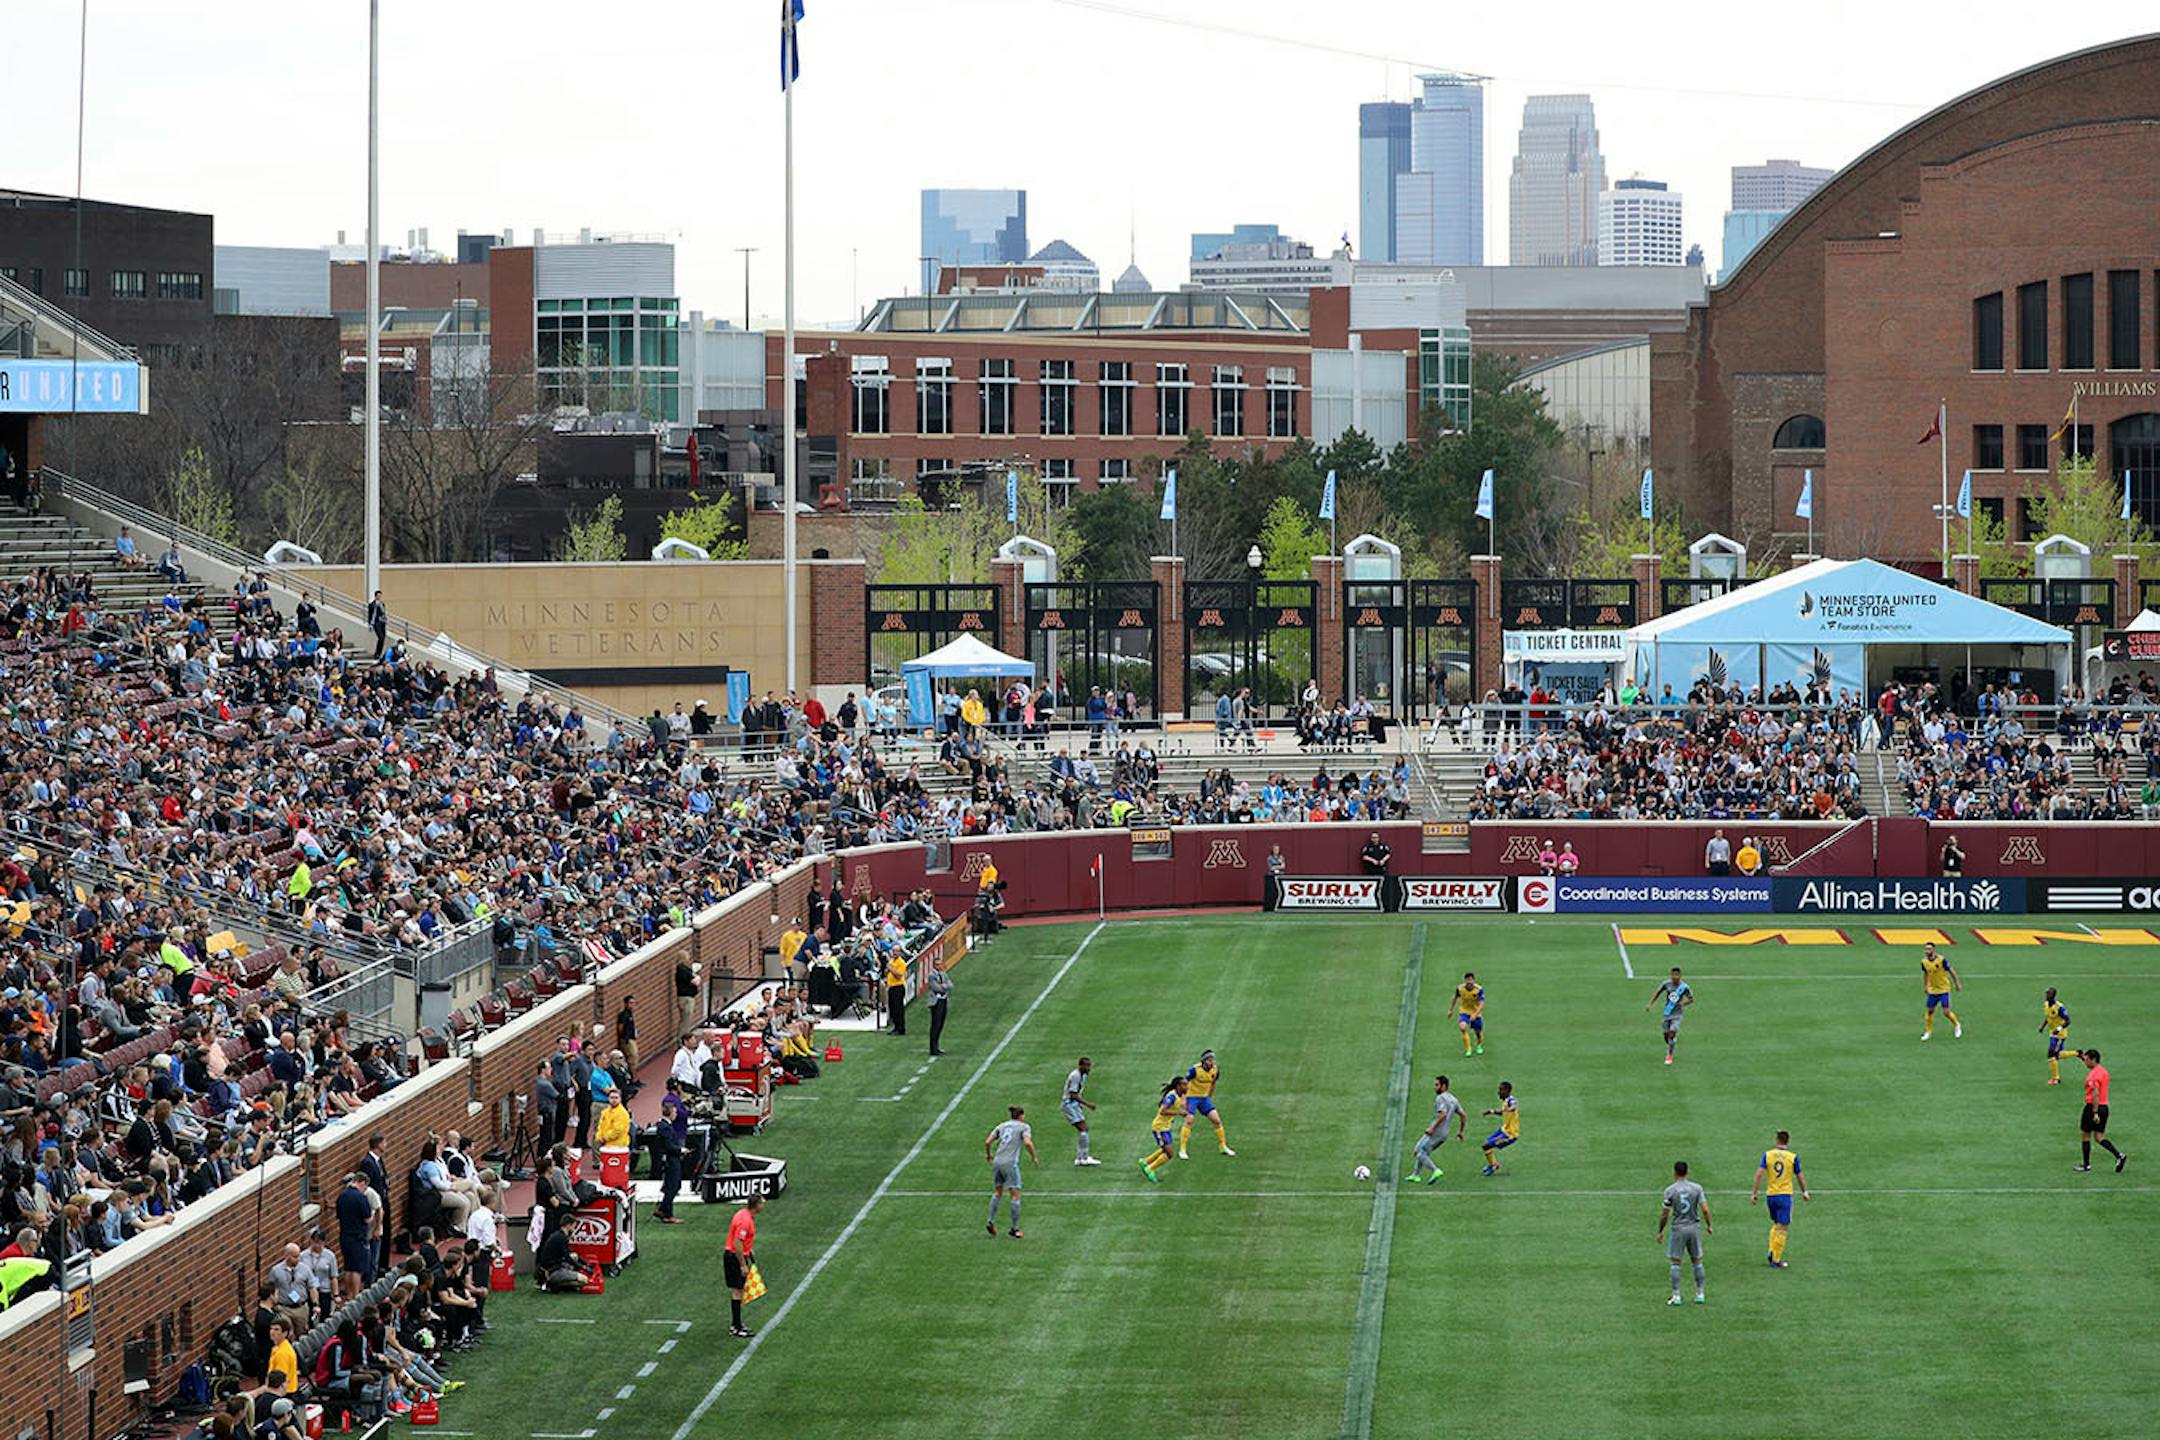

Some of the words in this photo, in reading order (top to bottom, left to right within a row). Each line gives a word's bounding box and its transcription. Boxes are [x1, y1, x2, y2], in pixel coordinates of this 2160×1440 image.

[20, 371, 122, 400] UNITED
[2073, 382, 2156, 396] WILLIAMS
[1820, 594, 1890, 606] MINNESOTA
[1893, 594, 1937, 606] UNITED
[487, 602, 724, 625] MINNESOTA
[1820, 605, 1854, 617] TEAM
[1857, 605, 1896, 617] STORE
[521, 631, 720, 654] VETERANS
[1526, 635, 1567, 650] TICKET
[1571, 635, 1622, 650] CENTRAL
[1203, 840, 1247, 868] M
[2000, 836, 2046, 865] M
[1288, 883, 1373, 897] SURLY
[1411, 883, 1497, 897] SURLY
[1559, 886, 1649, 901] Coordinated
[1651, 886, 1710, 901] Business
[1711, 887, 1769, 903] Systems
[1798, 881, 1874, 910] Allina
[1878, 881, 1966, 910] Health
[1774, 1161, 1785, 1178] 9
[715, 1178, 771, 1199] MNUFC
[1679, 1191, 1691, 1214] 5
